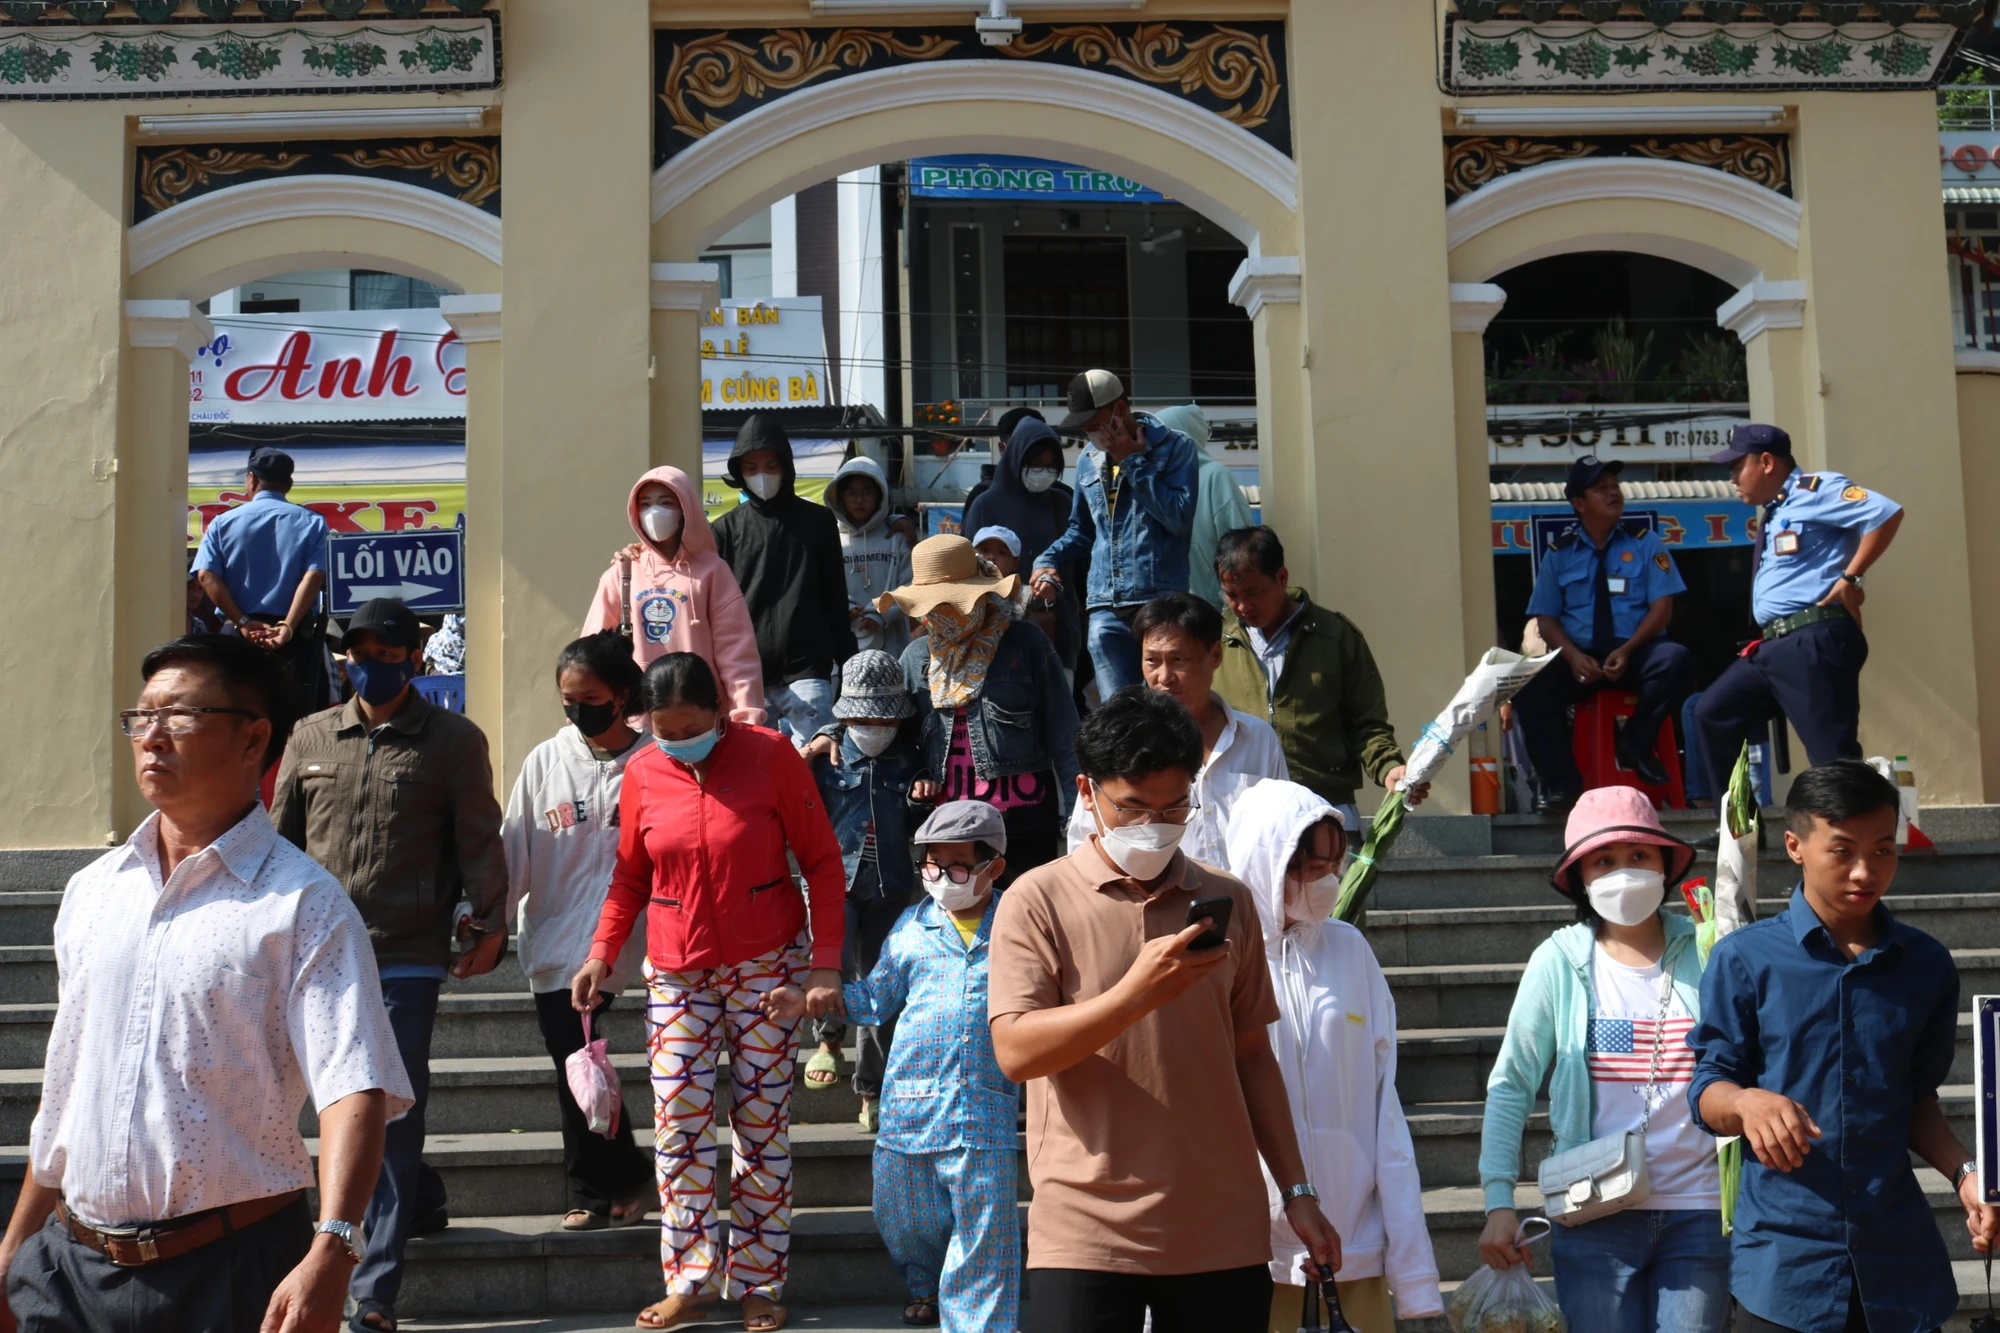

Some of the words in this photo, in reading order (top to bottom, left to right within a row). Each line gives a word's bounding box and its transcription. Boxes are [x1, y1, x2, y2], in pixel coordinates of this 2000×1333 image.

[921, 164, 1055, 192] PHÒNG
[737, 302, 779, 326] BÁN
[224, 330, 420, 401] Anh
[721, 370, 780, 403] CÚNG
[788, 370, 819, 401] BÀ
[337, 540, 385, 580] LỐI
[394, 541, 453, 576] VÀO
